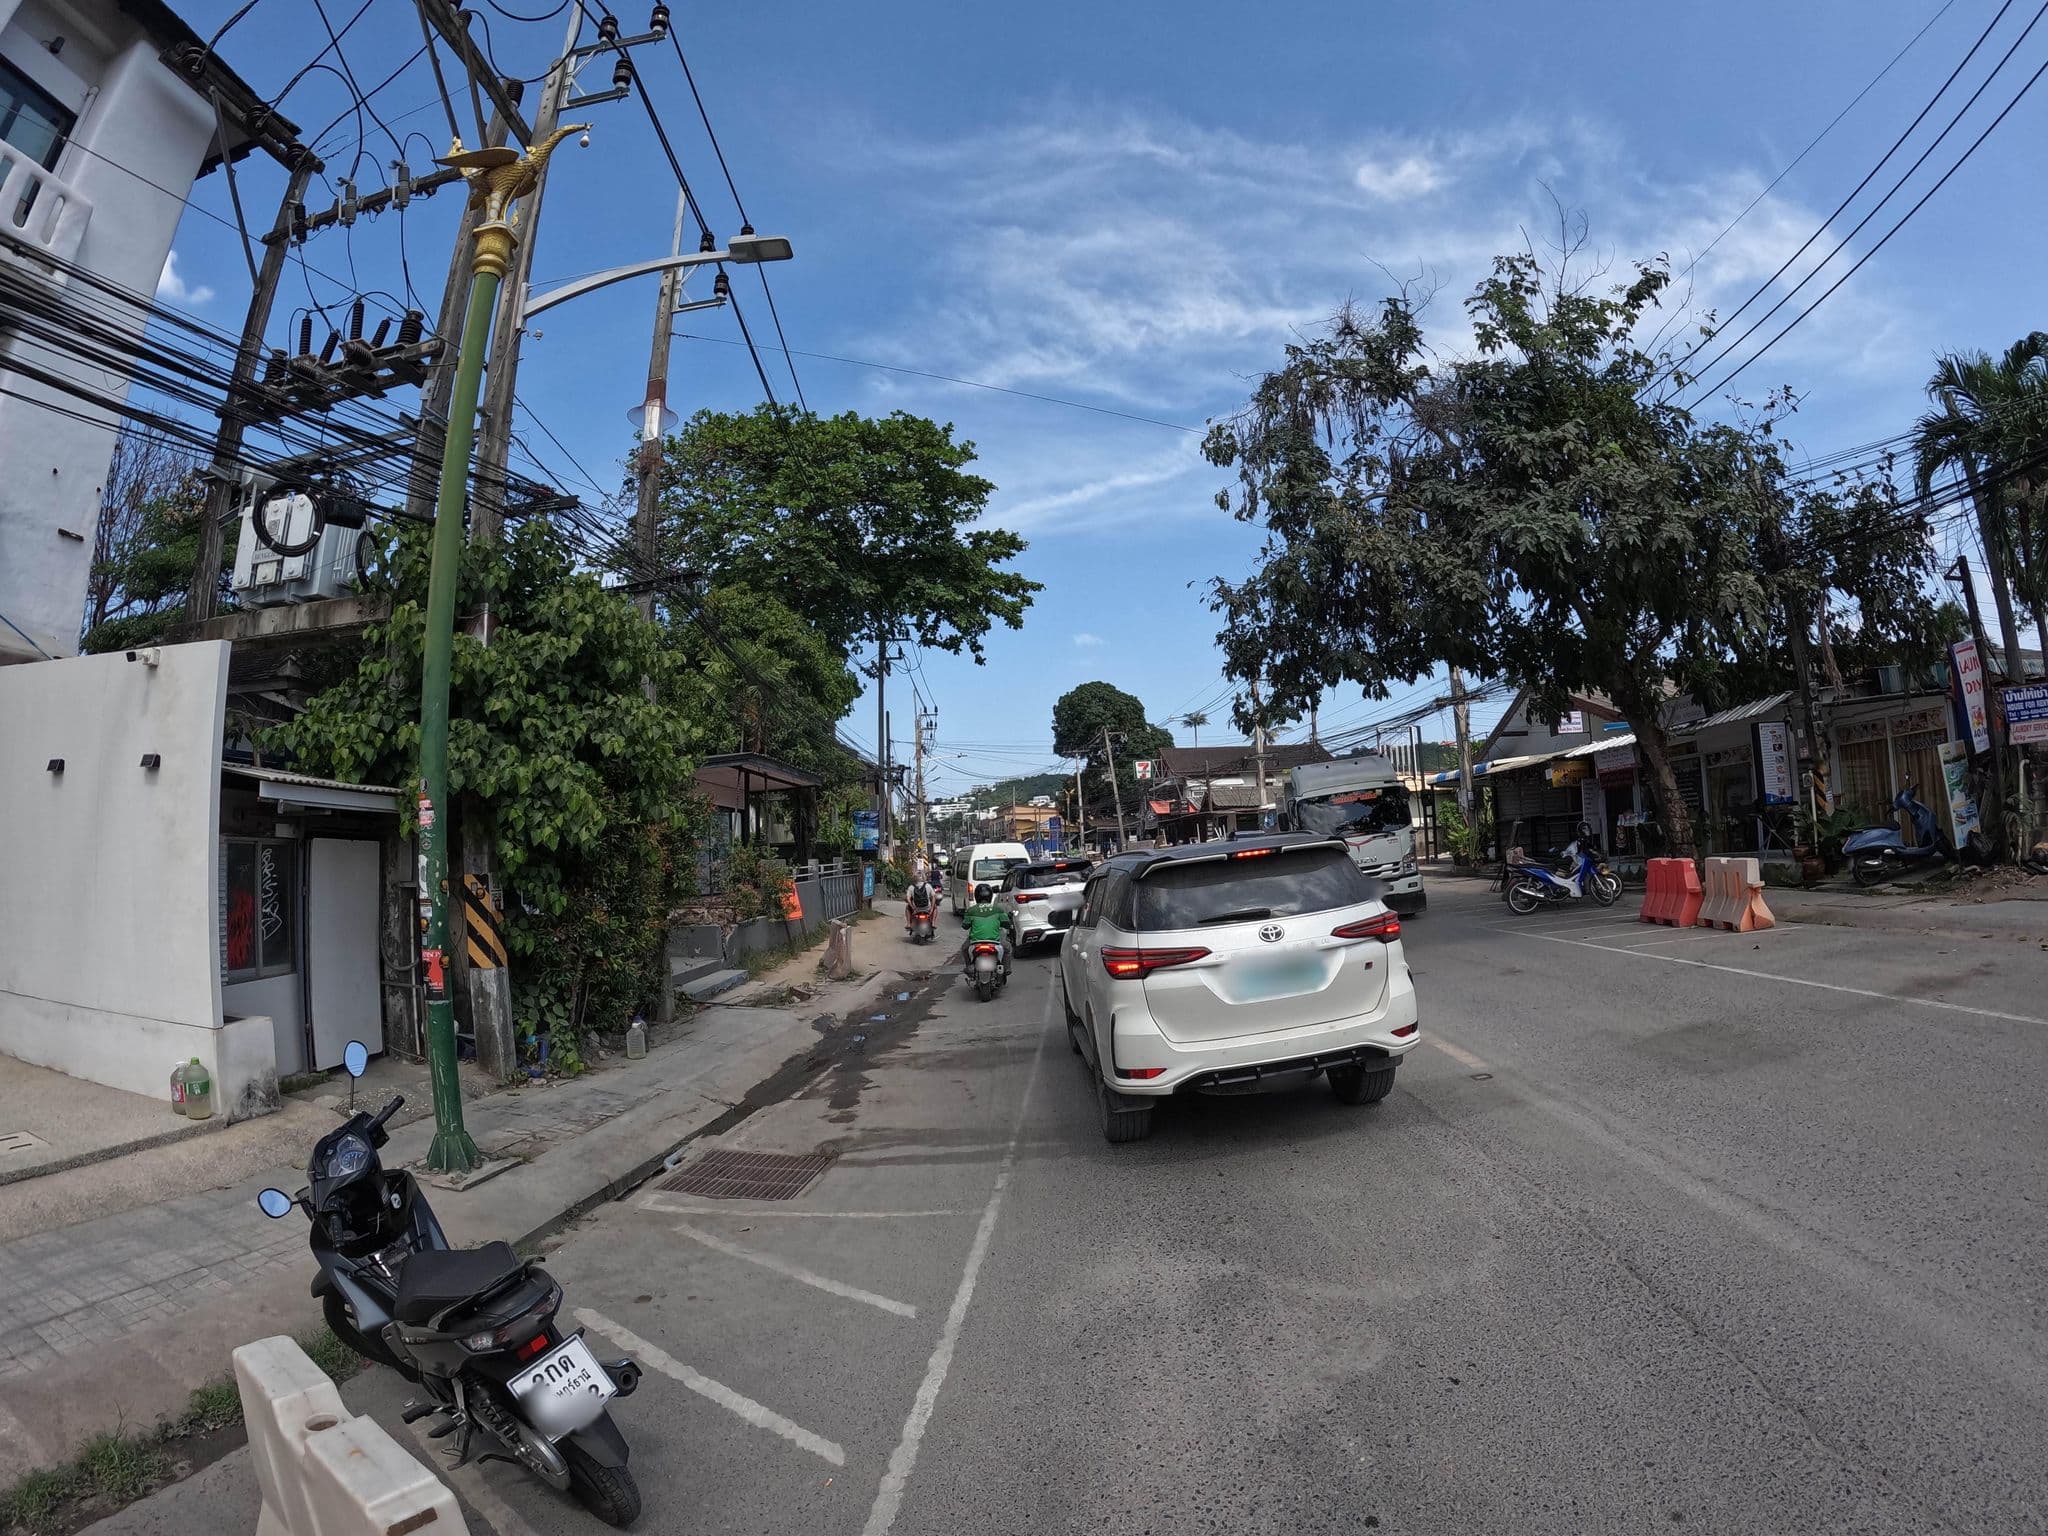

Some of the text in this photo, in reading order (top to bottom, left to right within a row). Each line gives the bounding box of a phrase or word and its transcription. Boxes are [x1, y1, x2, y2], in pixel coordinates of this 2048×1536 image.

[2006, 686, 2048, 702] บ้านให้เช่า
